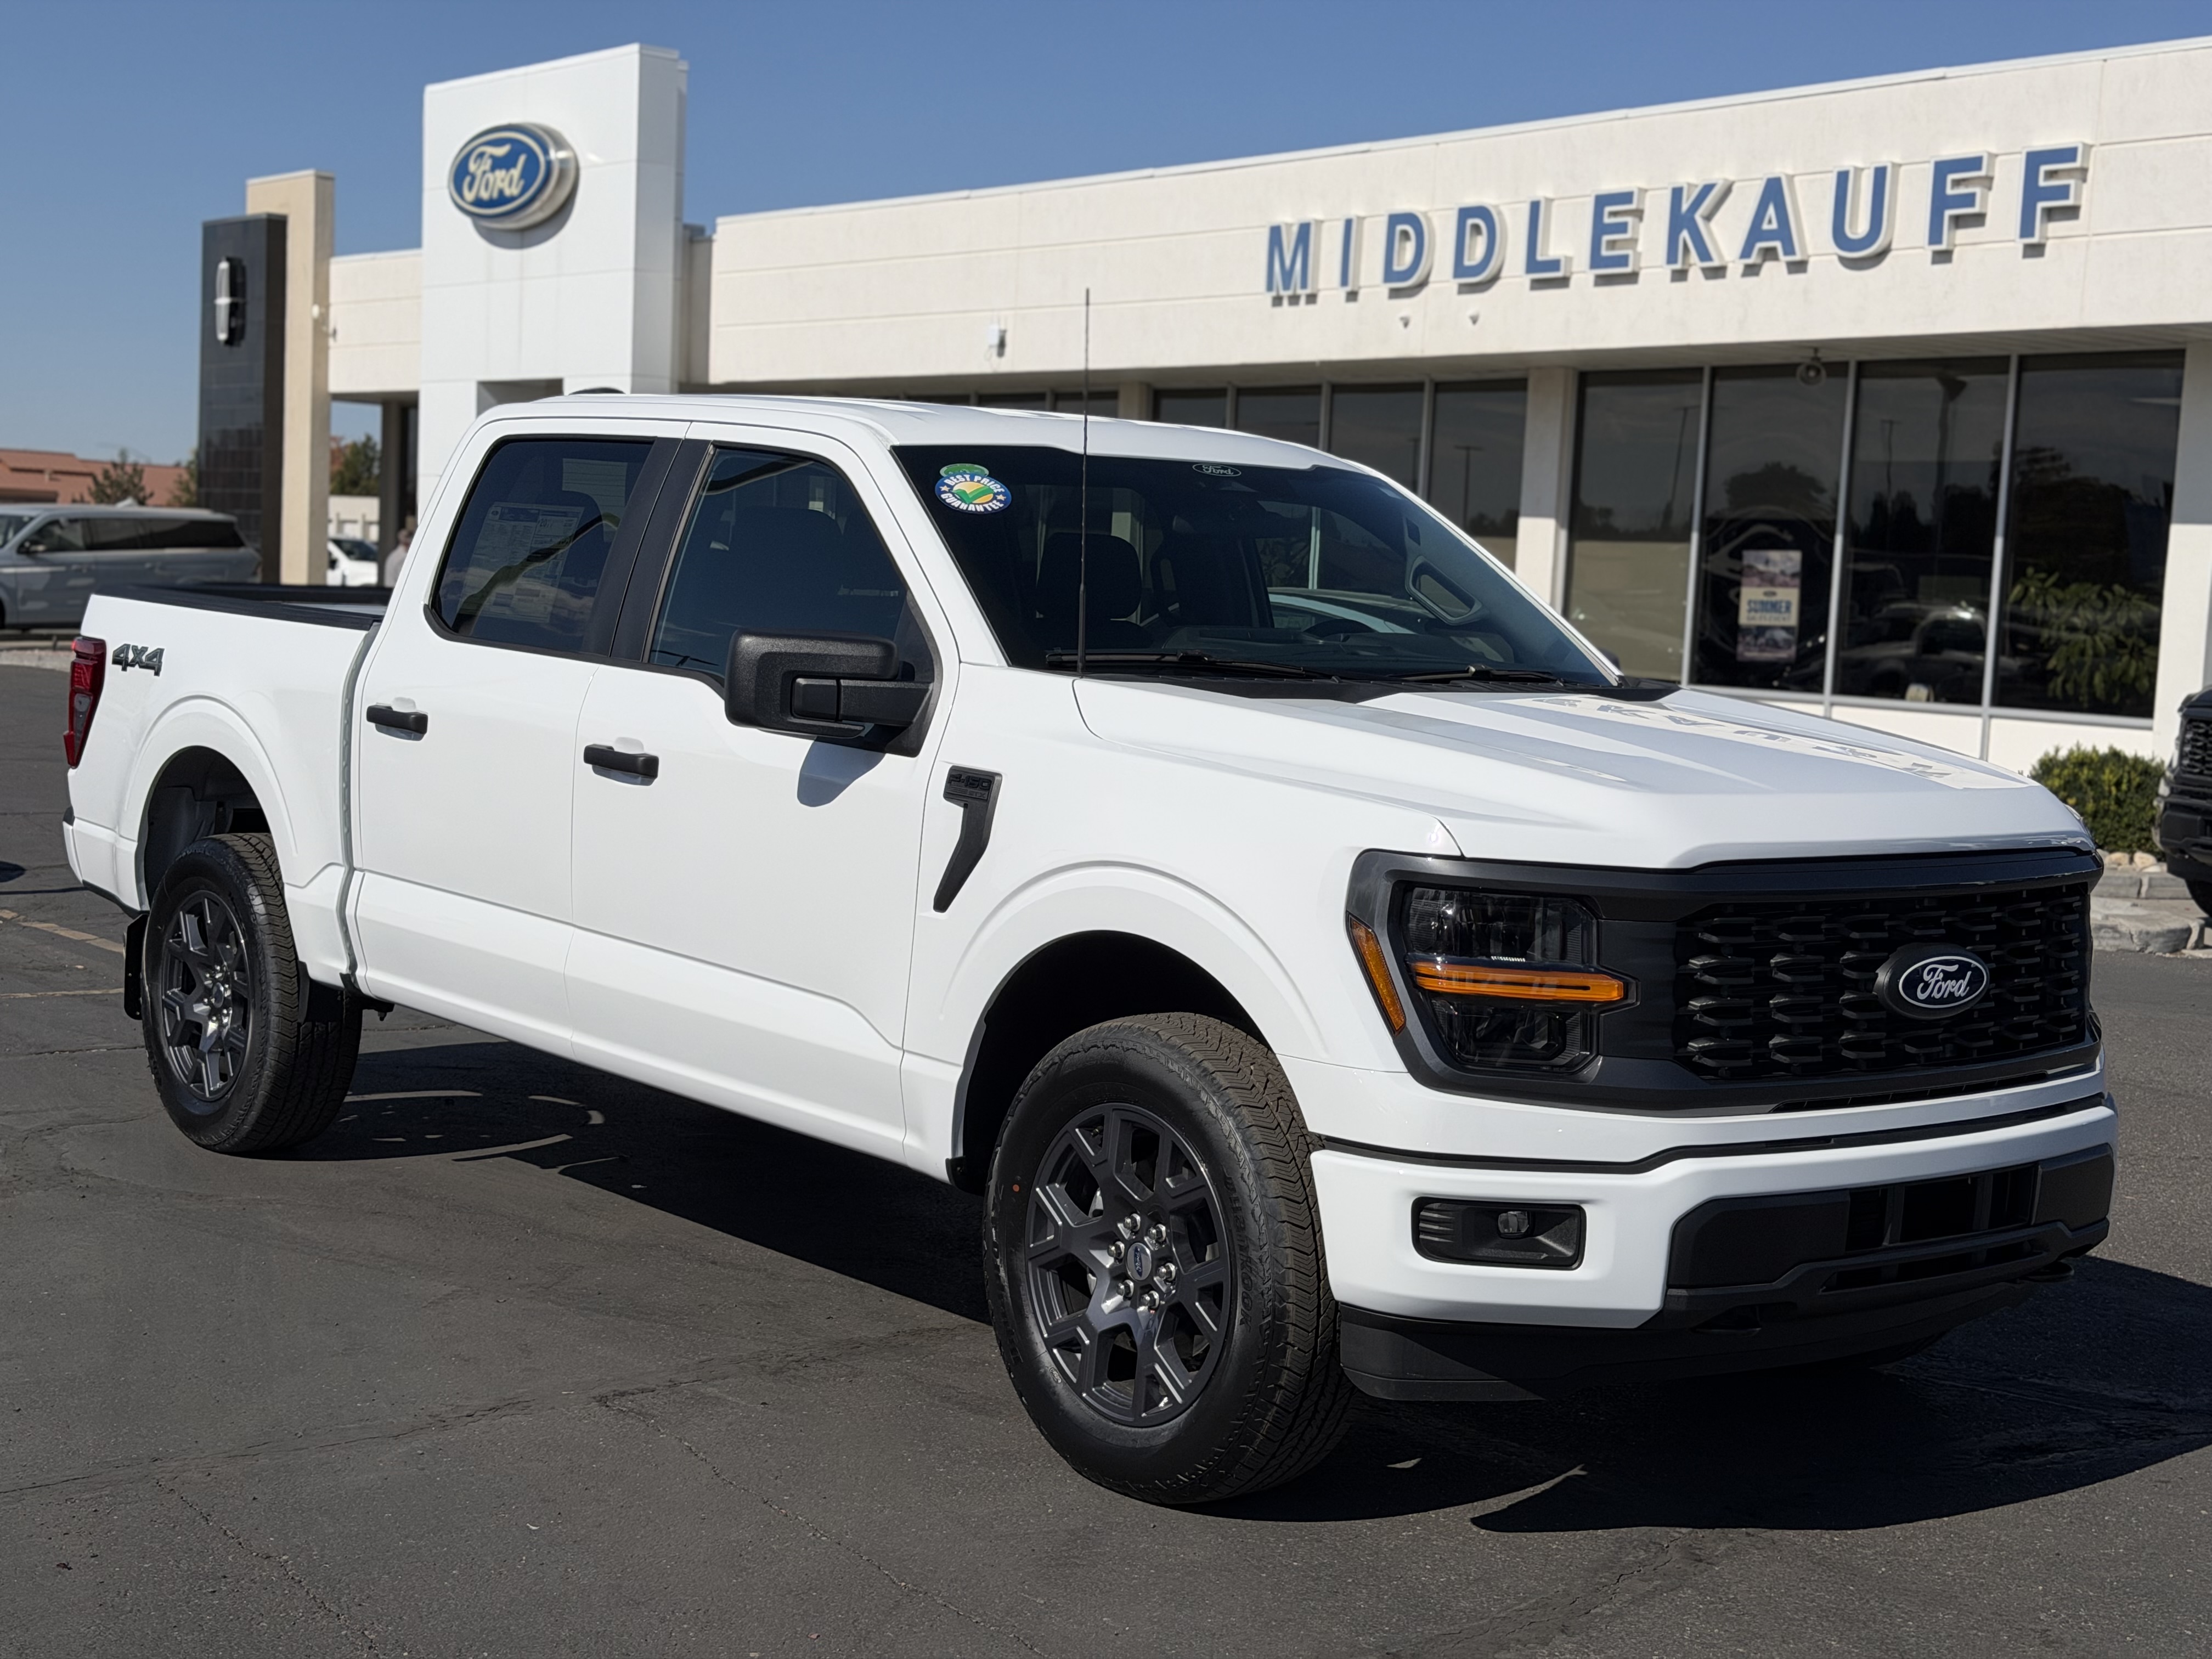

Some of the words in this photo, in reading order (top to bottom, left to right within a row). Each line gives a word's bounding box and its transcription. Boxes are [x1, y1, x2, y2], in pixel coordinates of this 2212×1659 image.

[462, 143, 527, 202] Ford
[1263, 143, 2089, 295] MIDDLEKAUFF
[943, 474, 970, 486] BEST
[973, 475, 1005, 493] PRICE
[1202, 465, 1234, 475] Ford
[940, 493, 1005, 512] GUARANTEE
[1916, 963, 1972, 1000] Ford
